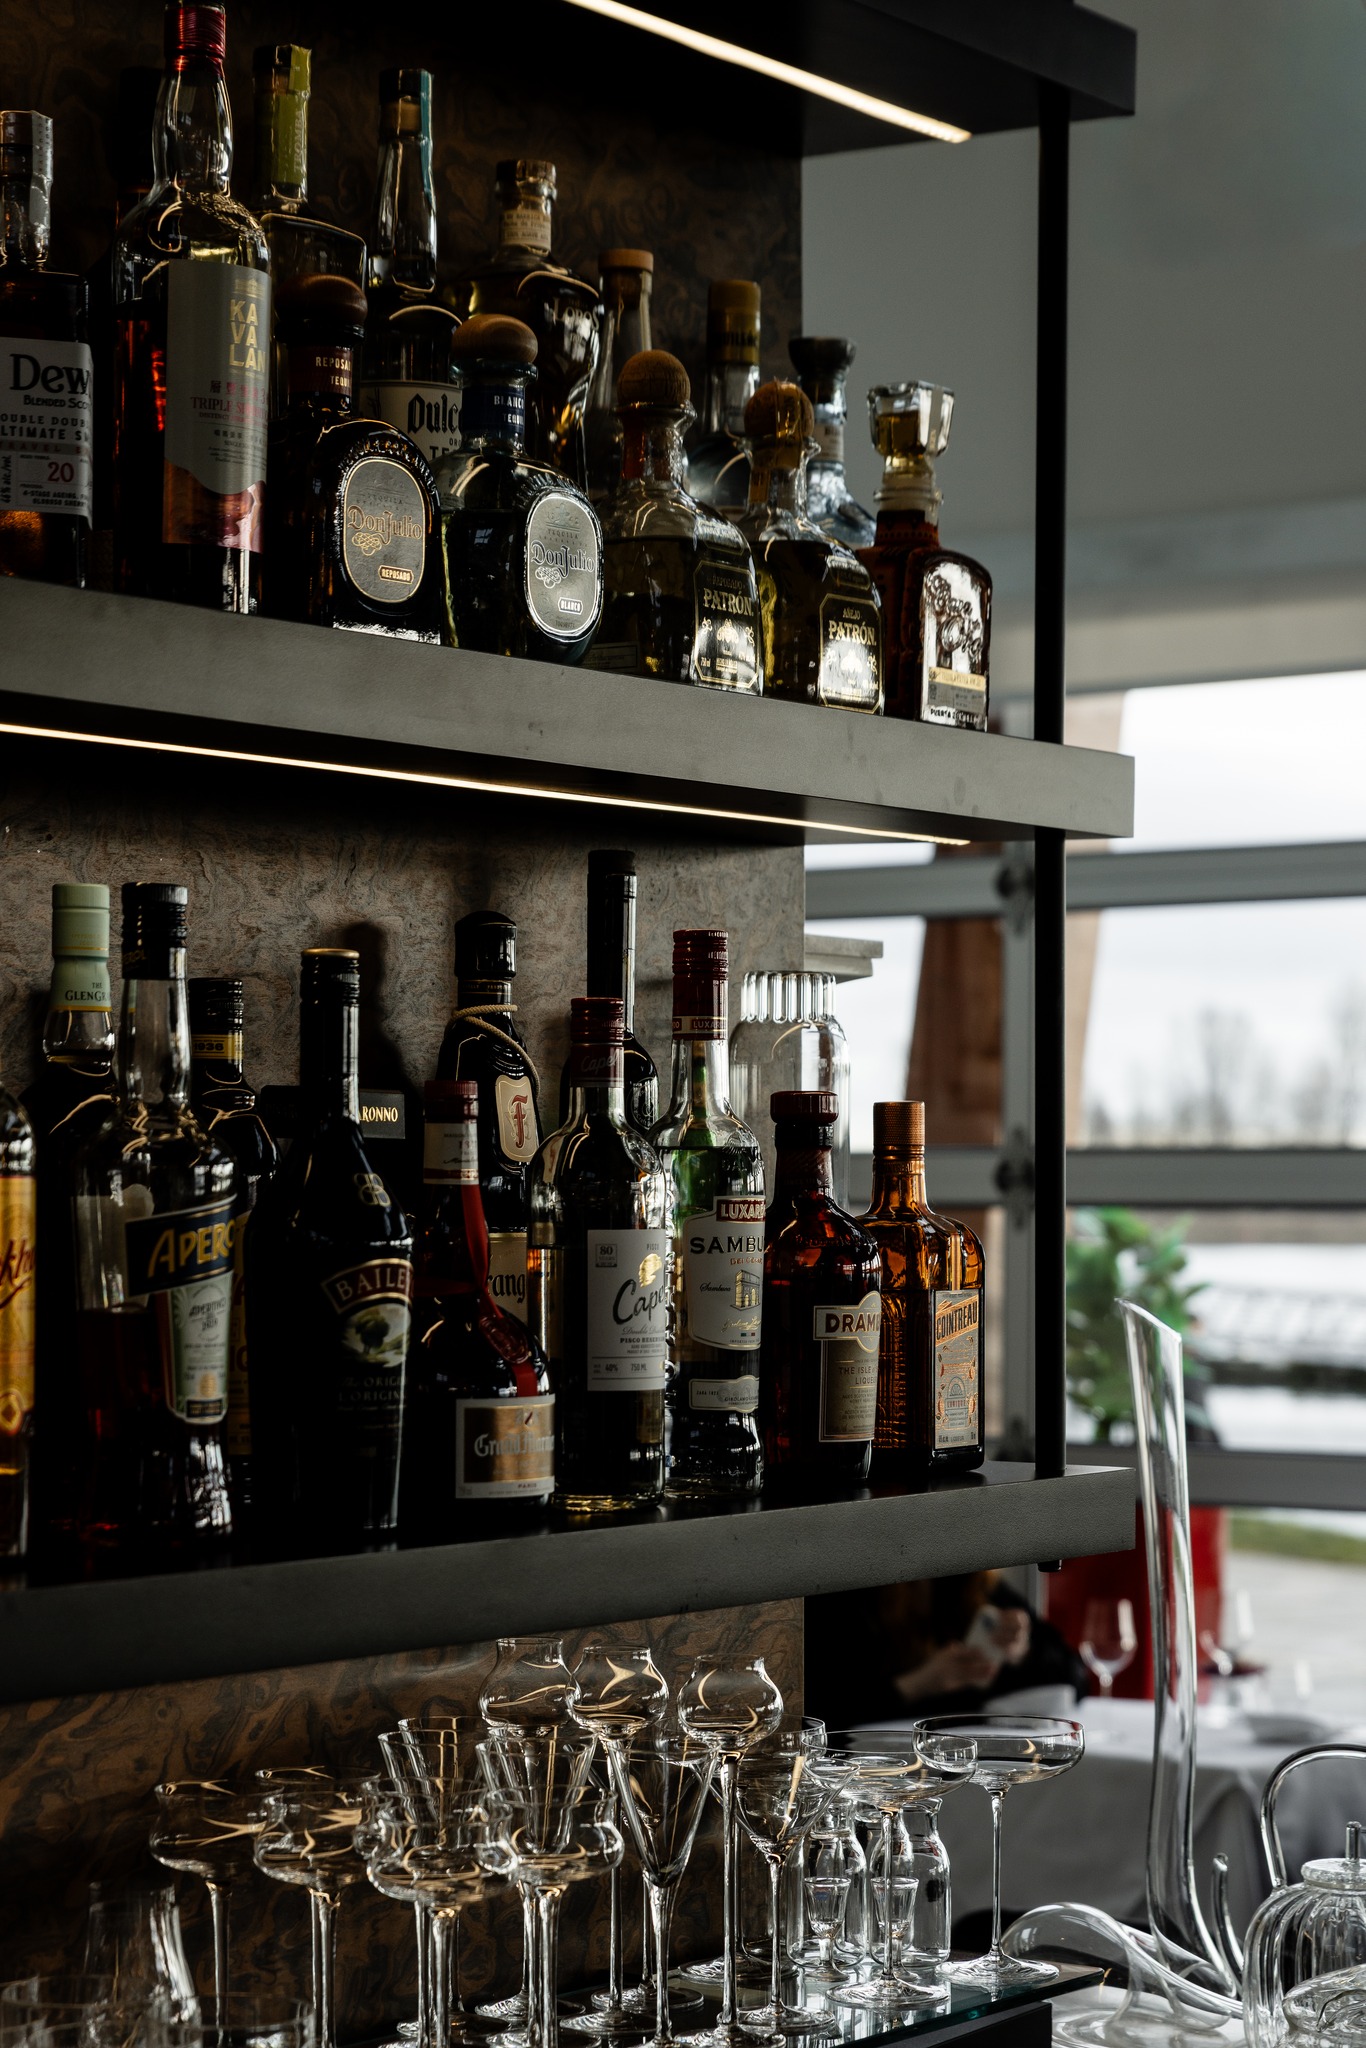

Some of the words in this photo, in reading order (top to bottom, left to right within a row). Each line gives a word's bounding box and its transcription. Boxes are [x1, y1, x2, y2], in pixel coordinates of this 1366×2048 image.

[10, 353, 90, 395] Dew
[48, 461, 75, 483] 20
[380, 567, 411, 582] REPOSADO
[560, 600, 581, 612] BLANCO
[193, 1042, 225, 1051] 1936
[600, 1245, 613, 1256] 80
[936, 1300, 978, 1341] COINTREAU
[839, 1366, 855, 1375] THE
